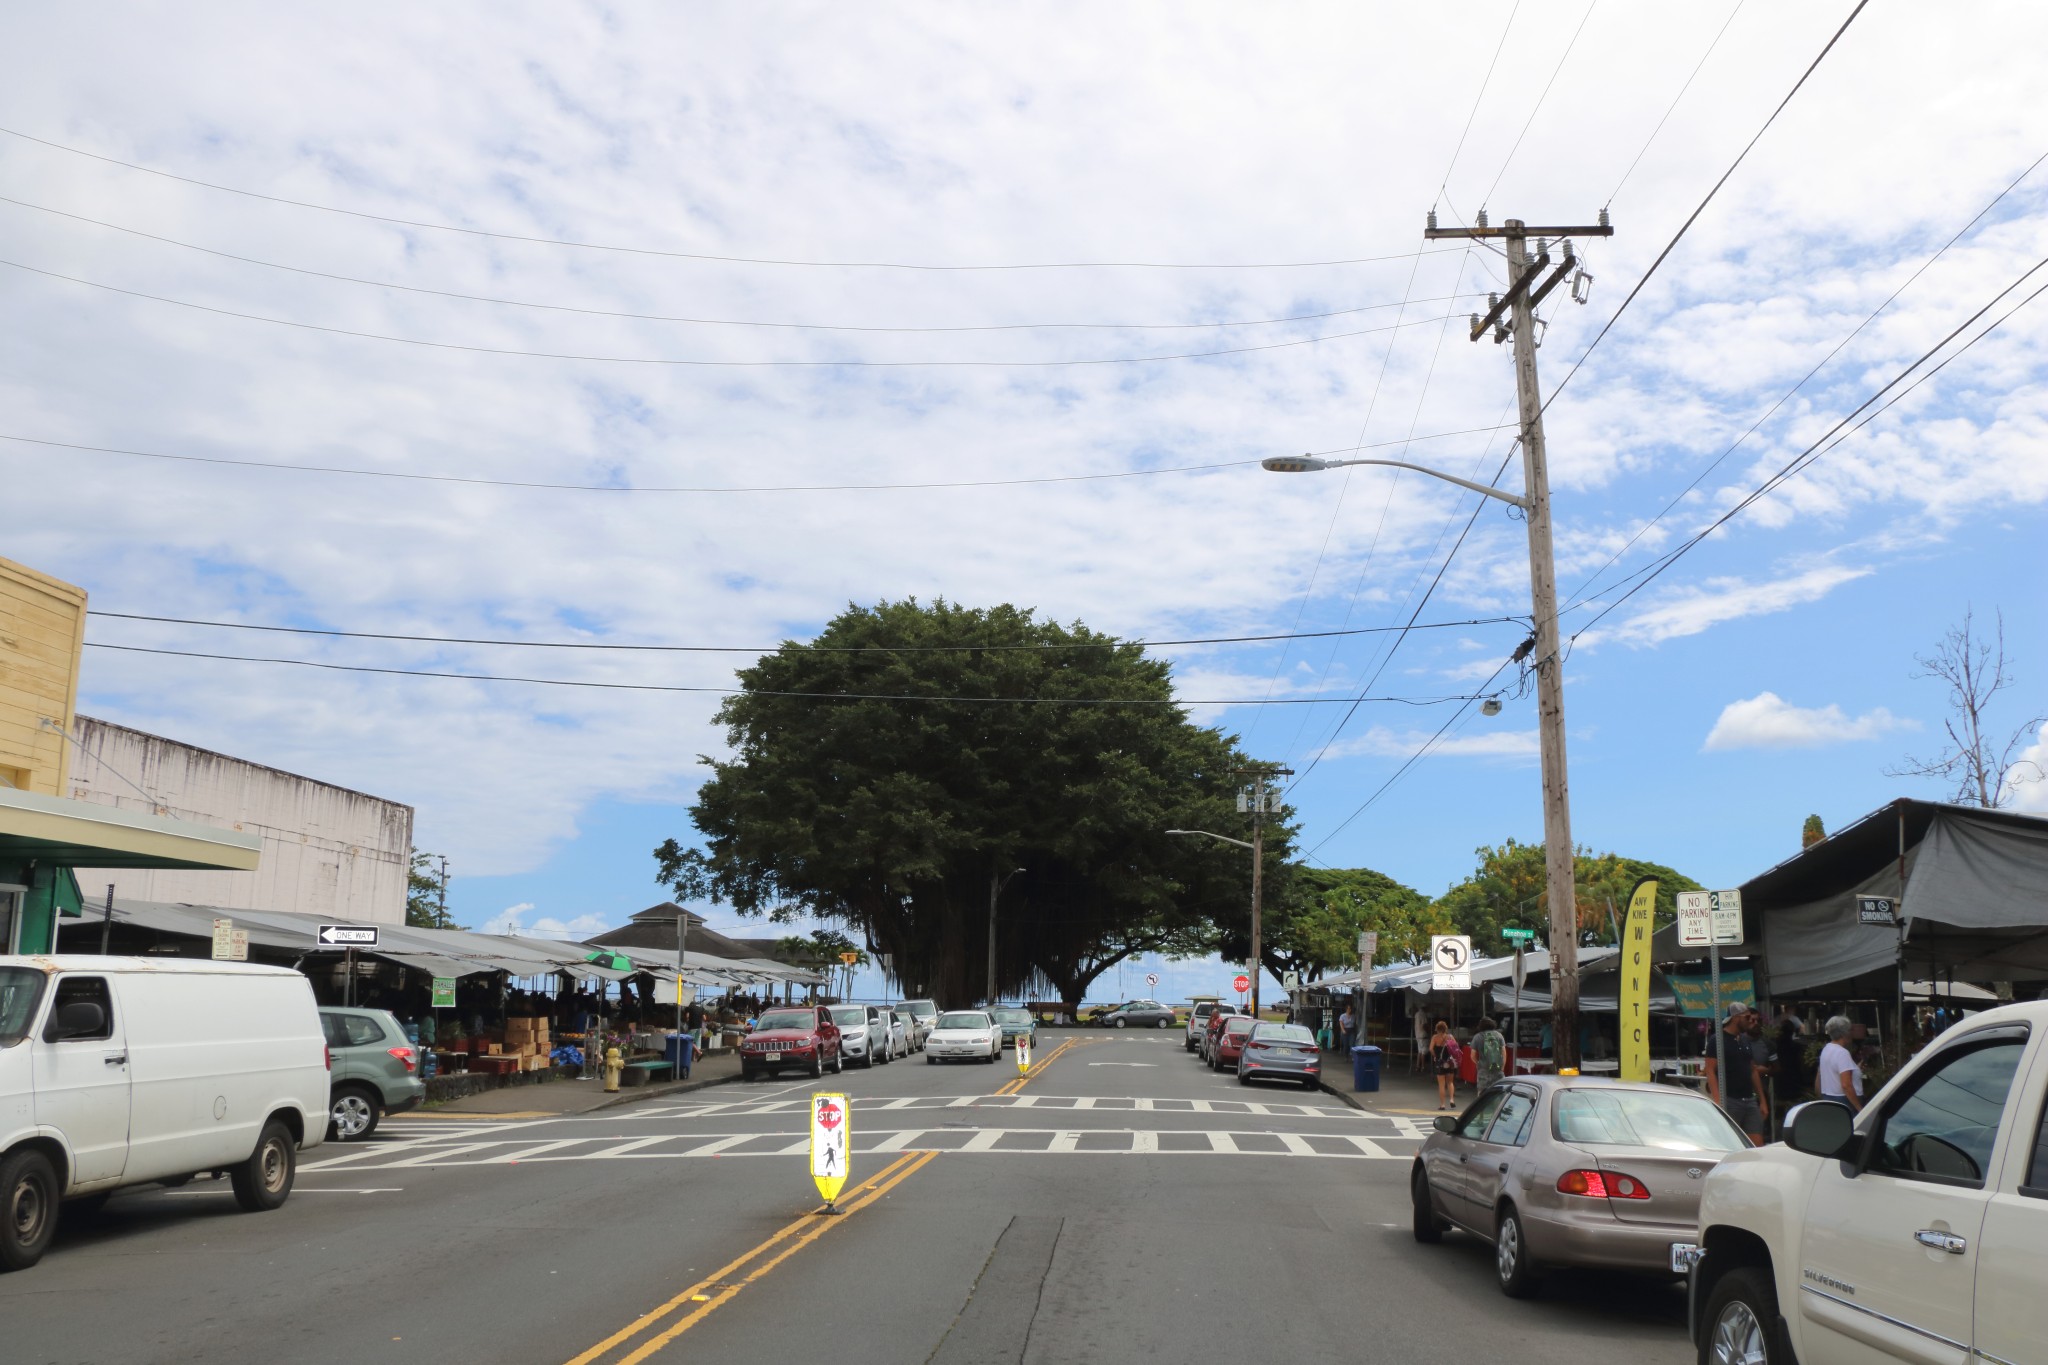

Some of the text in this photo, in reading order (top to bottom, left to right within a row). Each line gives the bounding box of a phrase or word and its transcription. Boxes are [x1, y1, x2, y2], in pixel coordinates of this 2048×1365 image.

[1635, 897, 1647, 906] ANY
[1688, 898, 1700, 907] NO
[1711, 895, 1719, 909] 2
[1864, 901, 1876, 911] NO
[1681, 908, 1709, 918] PARKING
[1861, 911, 1894, 921] SMOKING
[336, 931, 371, 939] ONE WAY
[1234, 980, 1249, 988] STOP
[818, 1111, 841, 1122] STOP
[1804, 1268, 1855, 1295] SILVERADO
